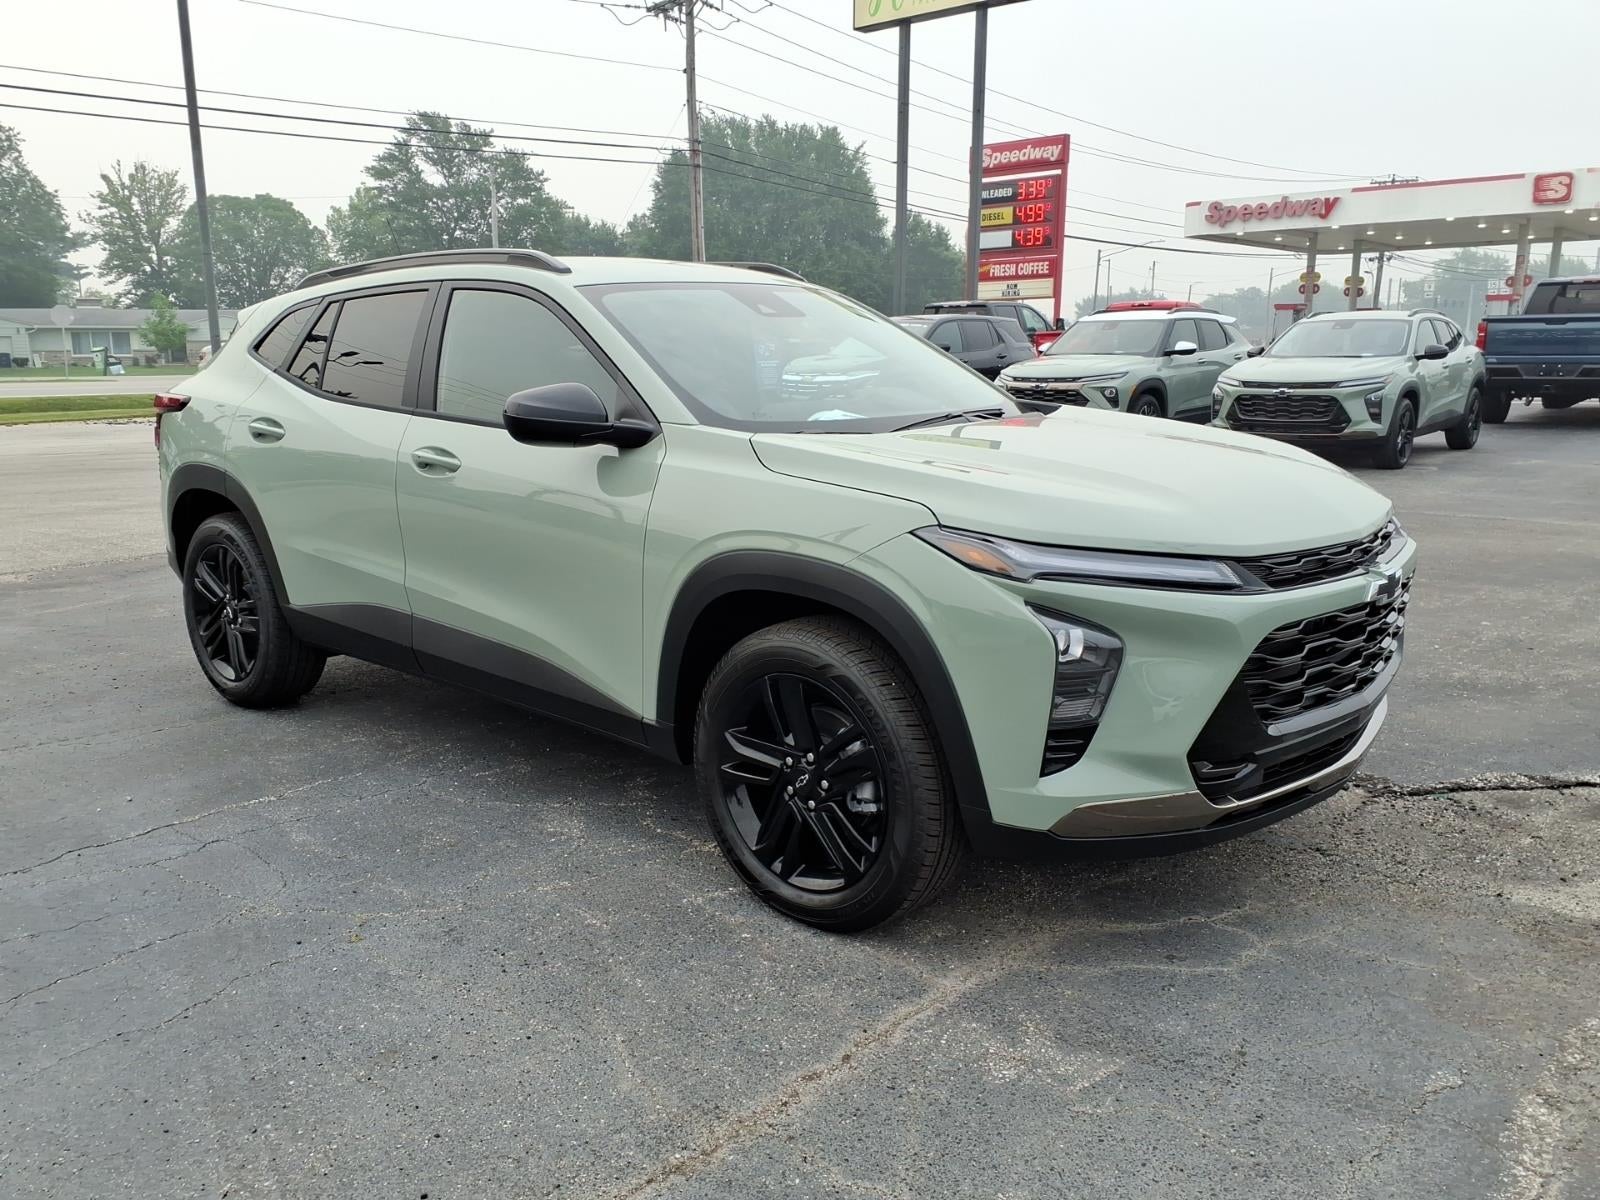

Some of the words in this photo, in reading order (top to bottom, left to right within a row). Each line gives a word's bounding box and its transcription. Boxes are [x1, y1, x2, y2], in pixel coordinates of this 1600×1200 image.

[982, 145, 1062, 168] Speedway
[981, 188, 1013, 199] NLEADED
[981, 211, 1005, 222] DIESEL
[1205, 195, 1341, 228] Speedway
[989, 264, 1016, 277] FRESH
[1018, 261, 1049, 275] COFFEE
